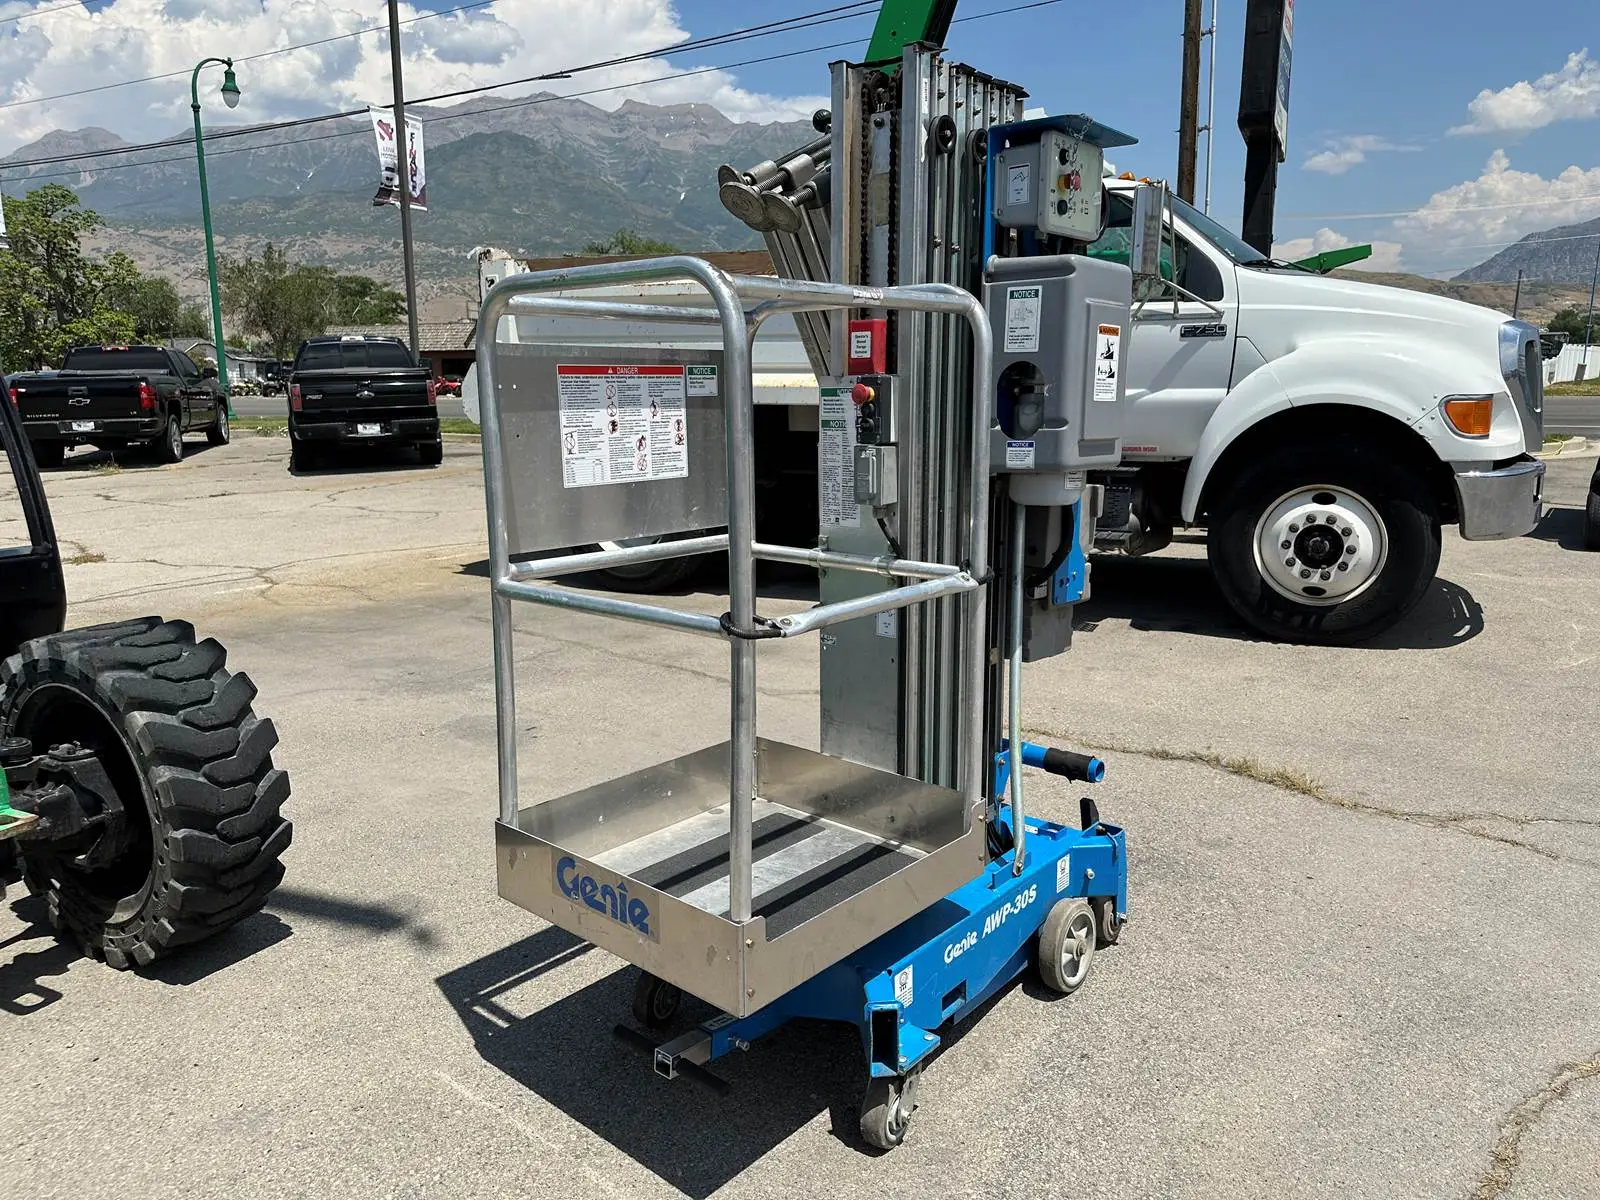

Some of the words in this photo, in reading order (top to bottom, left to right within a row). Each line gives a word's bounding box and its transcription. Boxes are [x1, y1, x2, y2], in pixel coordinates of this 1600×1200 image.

[1013, 290, 1036, 298] NOTICE
[1181, 324, 1226, 334] F-750
[830, 420, 846, 428] NOTI
[556, 856, 650, 936] Genie
[944, 931, 978, 964] Genie
[981, 883, 1038, 939] AWP-30S
